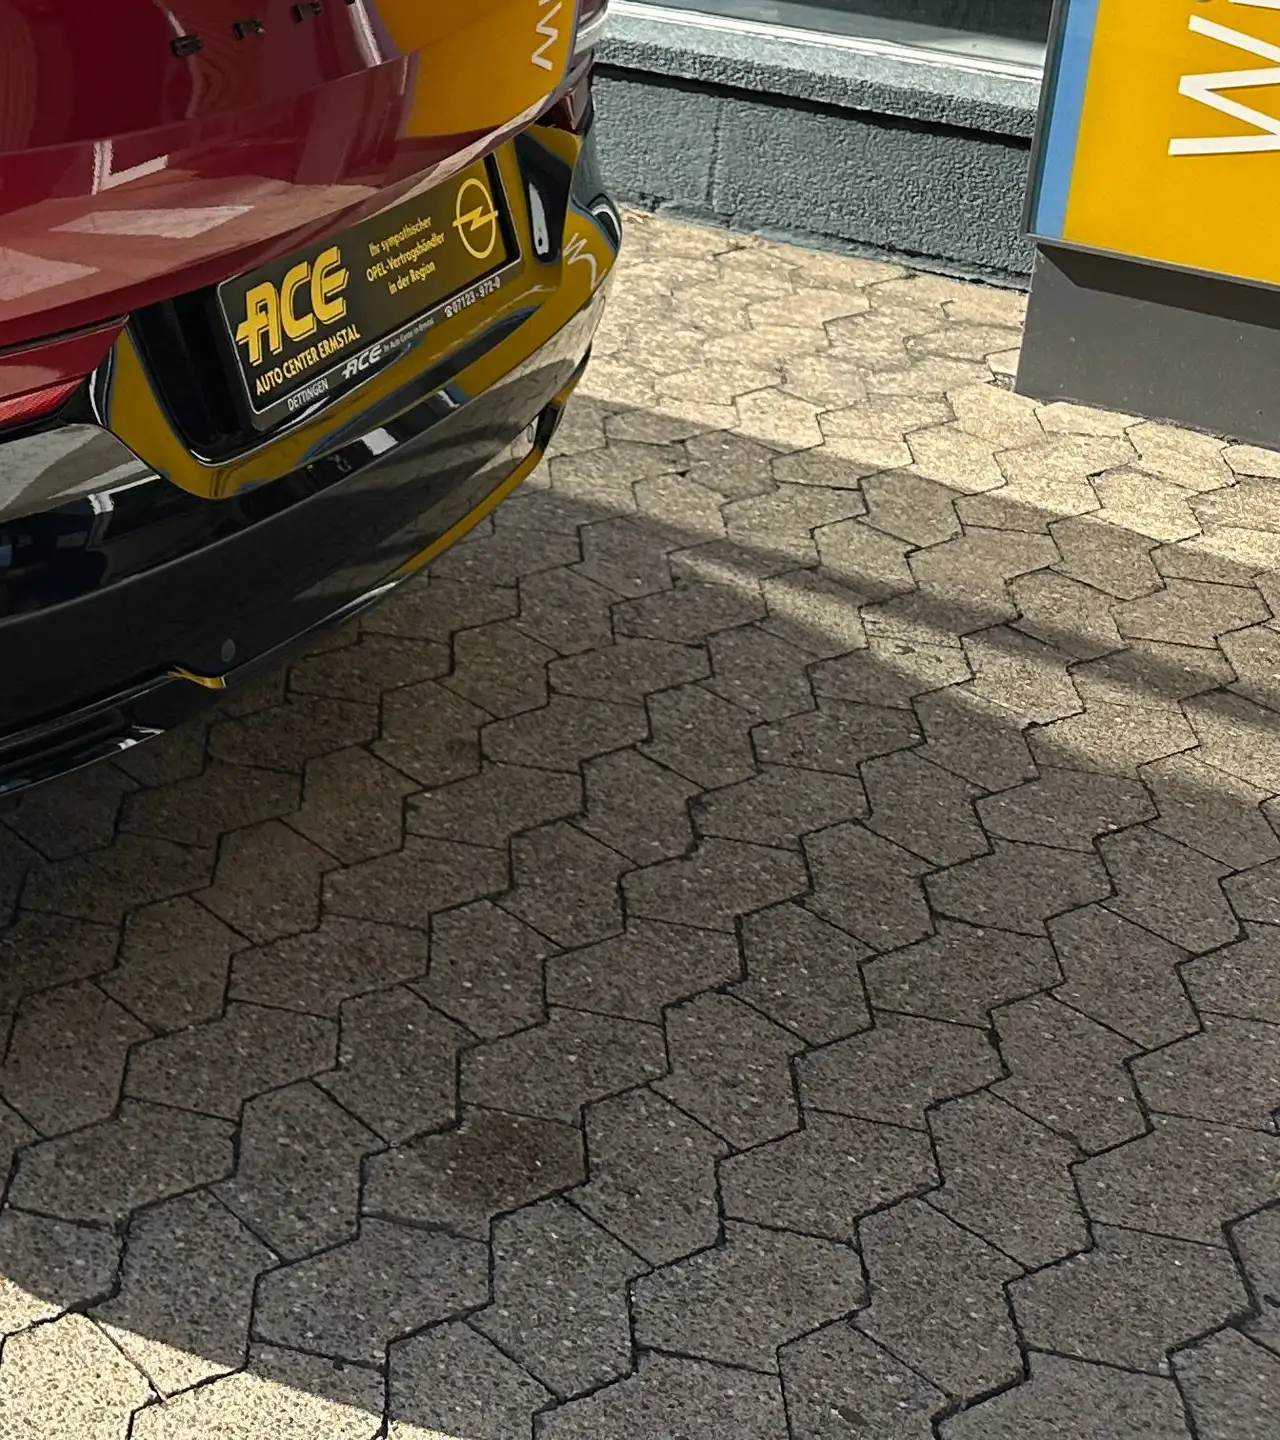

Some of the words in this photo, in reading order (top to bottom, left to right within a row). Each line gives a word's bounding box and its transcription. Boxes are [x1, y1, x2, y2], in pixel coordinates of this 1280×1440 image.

[388, 280, 398, 295] in
[397, 274, 411, 290] der
[410, 261, 436, 284] Region
[235, 246, 350, 367] ACE
[254, 366, 283, 396] AUTO
[283, 348, 320, 379] CENTER
[319, 324, 361, 358] ERMSTAL
[342, 344, 381, 379] ACE
